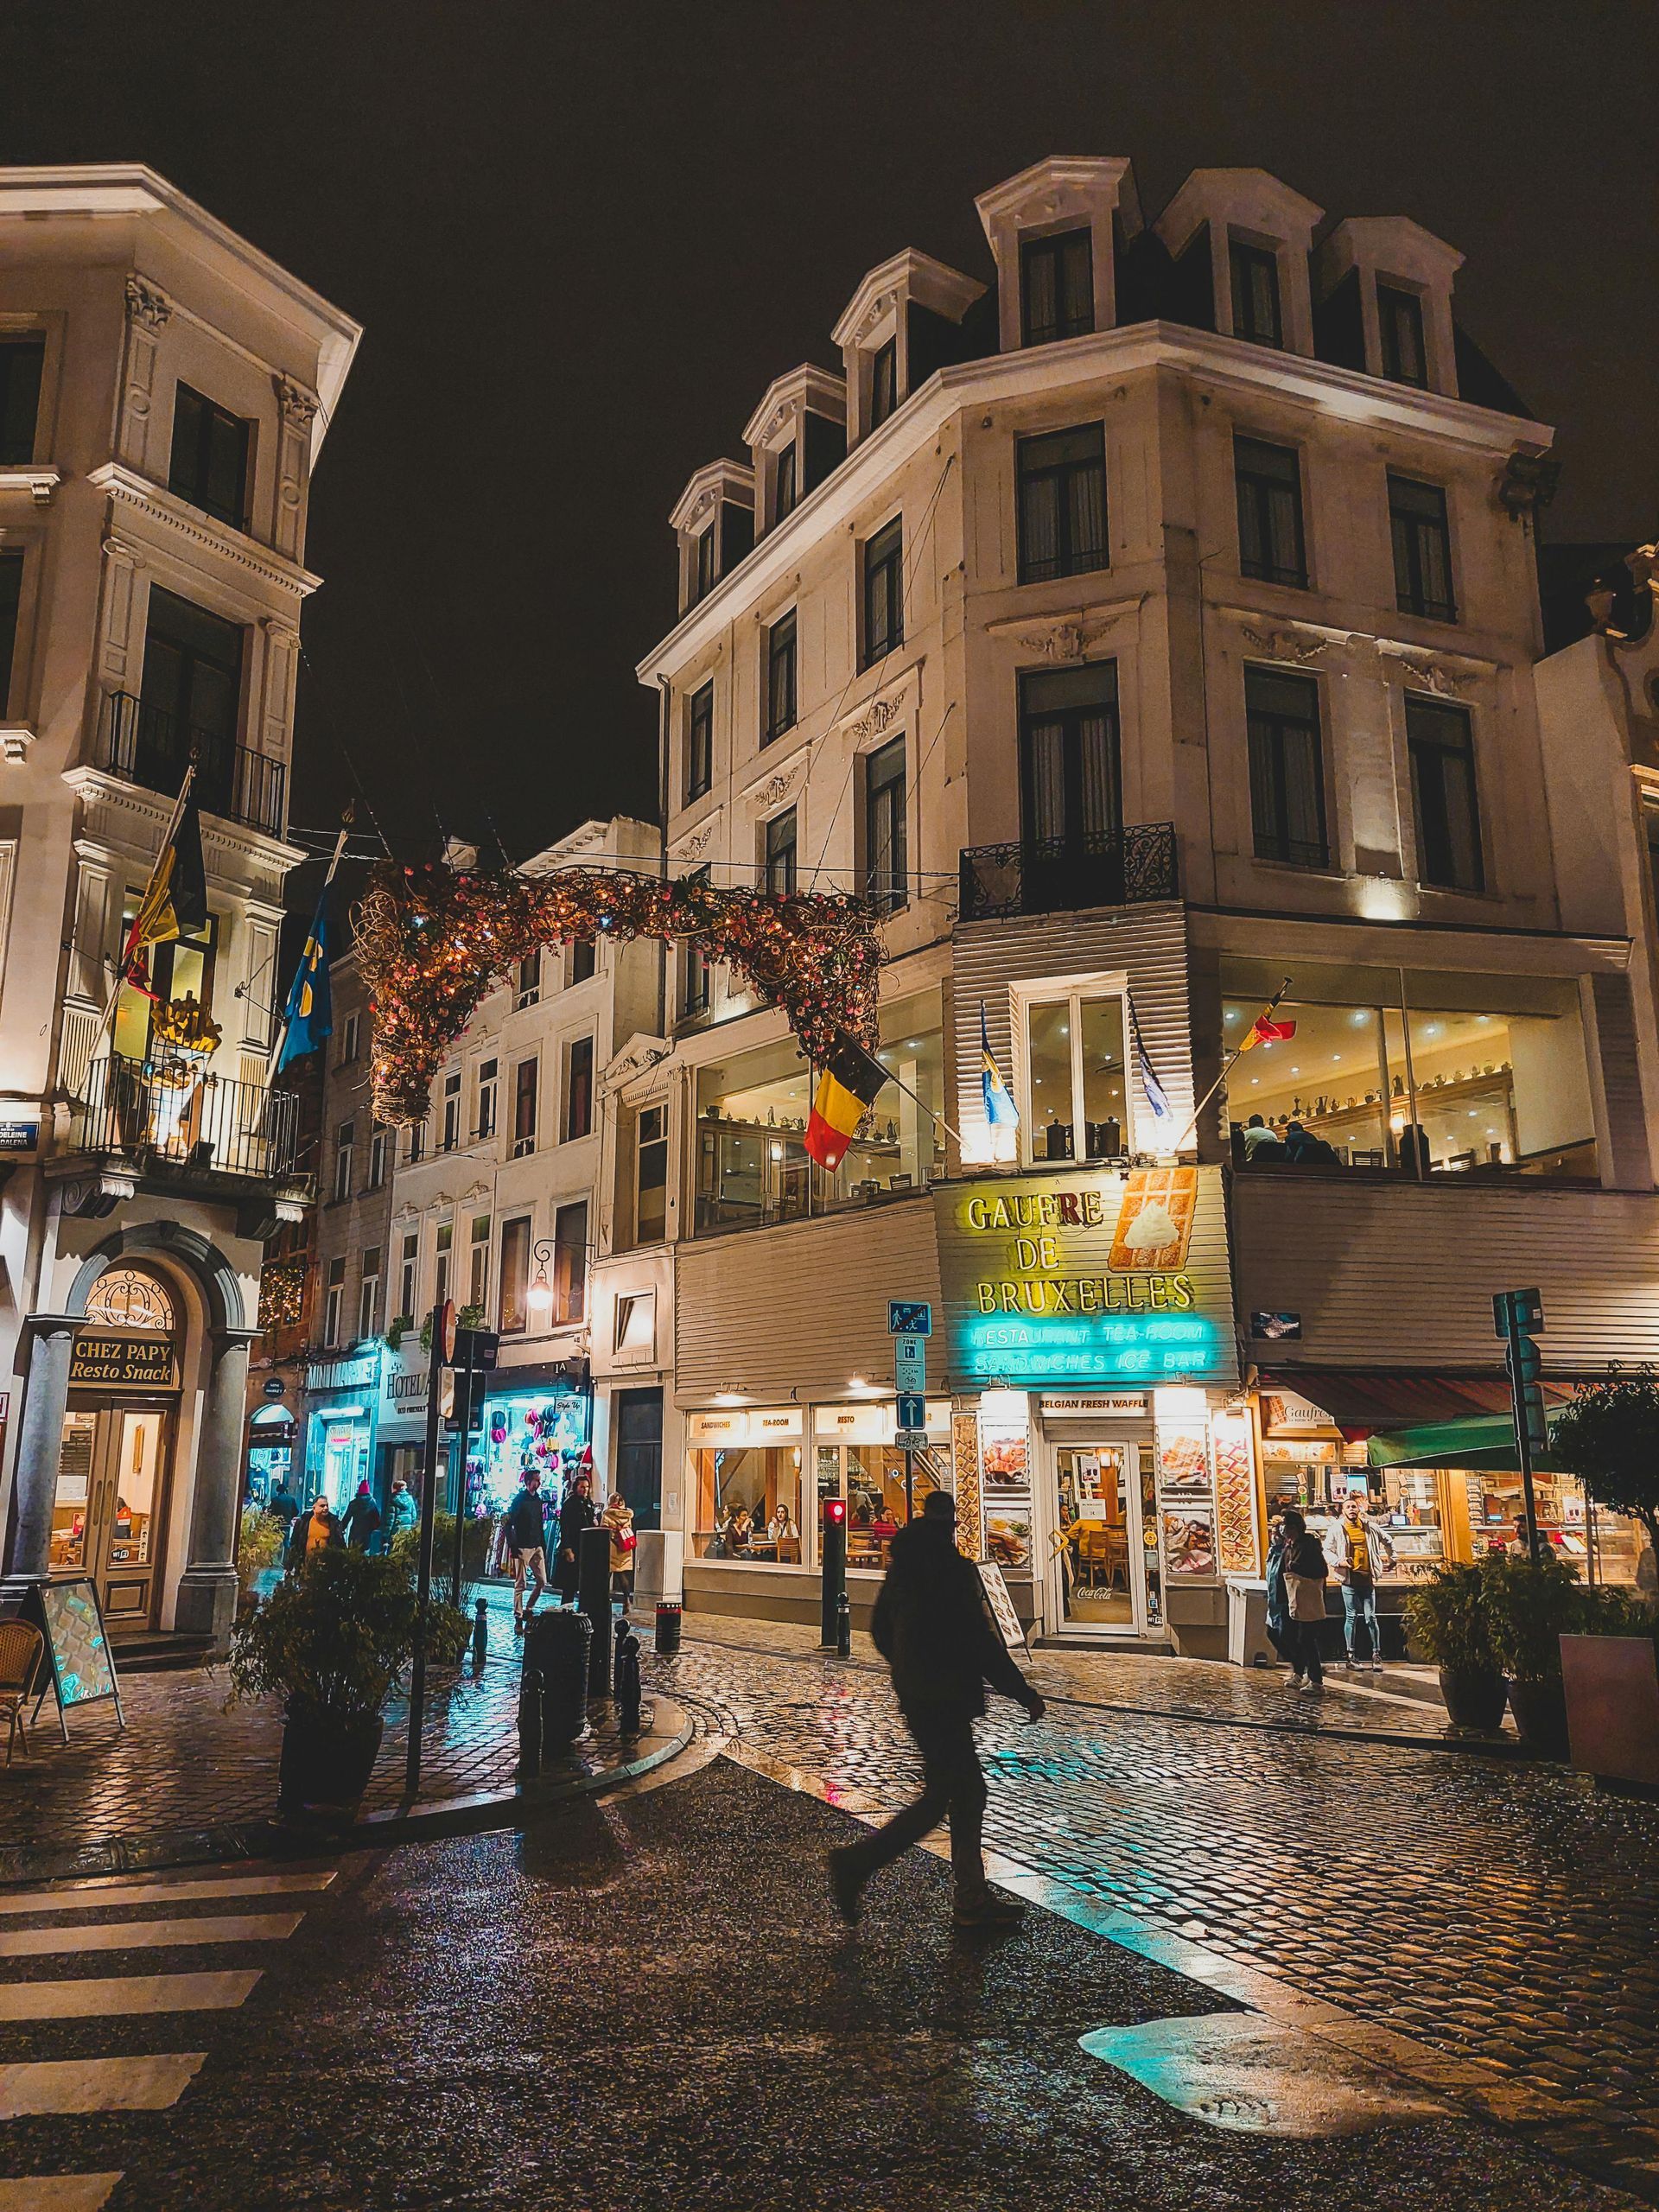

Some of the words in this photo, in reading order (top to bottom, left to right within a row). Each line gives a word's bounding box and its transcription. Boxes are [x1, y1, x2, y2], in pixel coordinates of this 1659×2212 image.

[968, 1191, 1104, 1231] GAUFRE
[1014, 1237, 1059, 1271] DE
[976, 1274, 1194, 1314] BRUXELLES
[972, 1327, 1090, 1347] RESTAURANT
[1103, 1324, 1204, 1342] TEA-ROOM
[75, 1341, 122, 1359] CHEZ
[126, 1344, 171, 1362] PAPY
[975, 1354, 1105, 1372] SANDWICHES
[1116, 1353, 1150, 1370] ICE
[1163, 1351, 1206, 1369] BAR
[70, 1361, 120, 1379] Resto
[122, 1363, 171, 1381] Snack
[555, 1362, 566, 1374] 1A
[386, 1372, 423, 1400] HOTEL
[1039, 1400, 1078, 1409] BELGIAN
[1081, 1400, 1110, 1408] FRESH
[1112, 1399, 1149, 1408] WAFFLE
[701, 1421, 731, 1430] SANDWICHES
